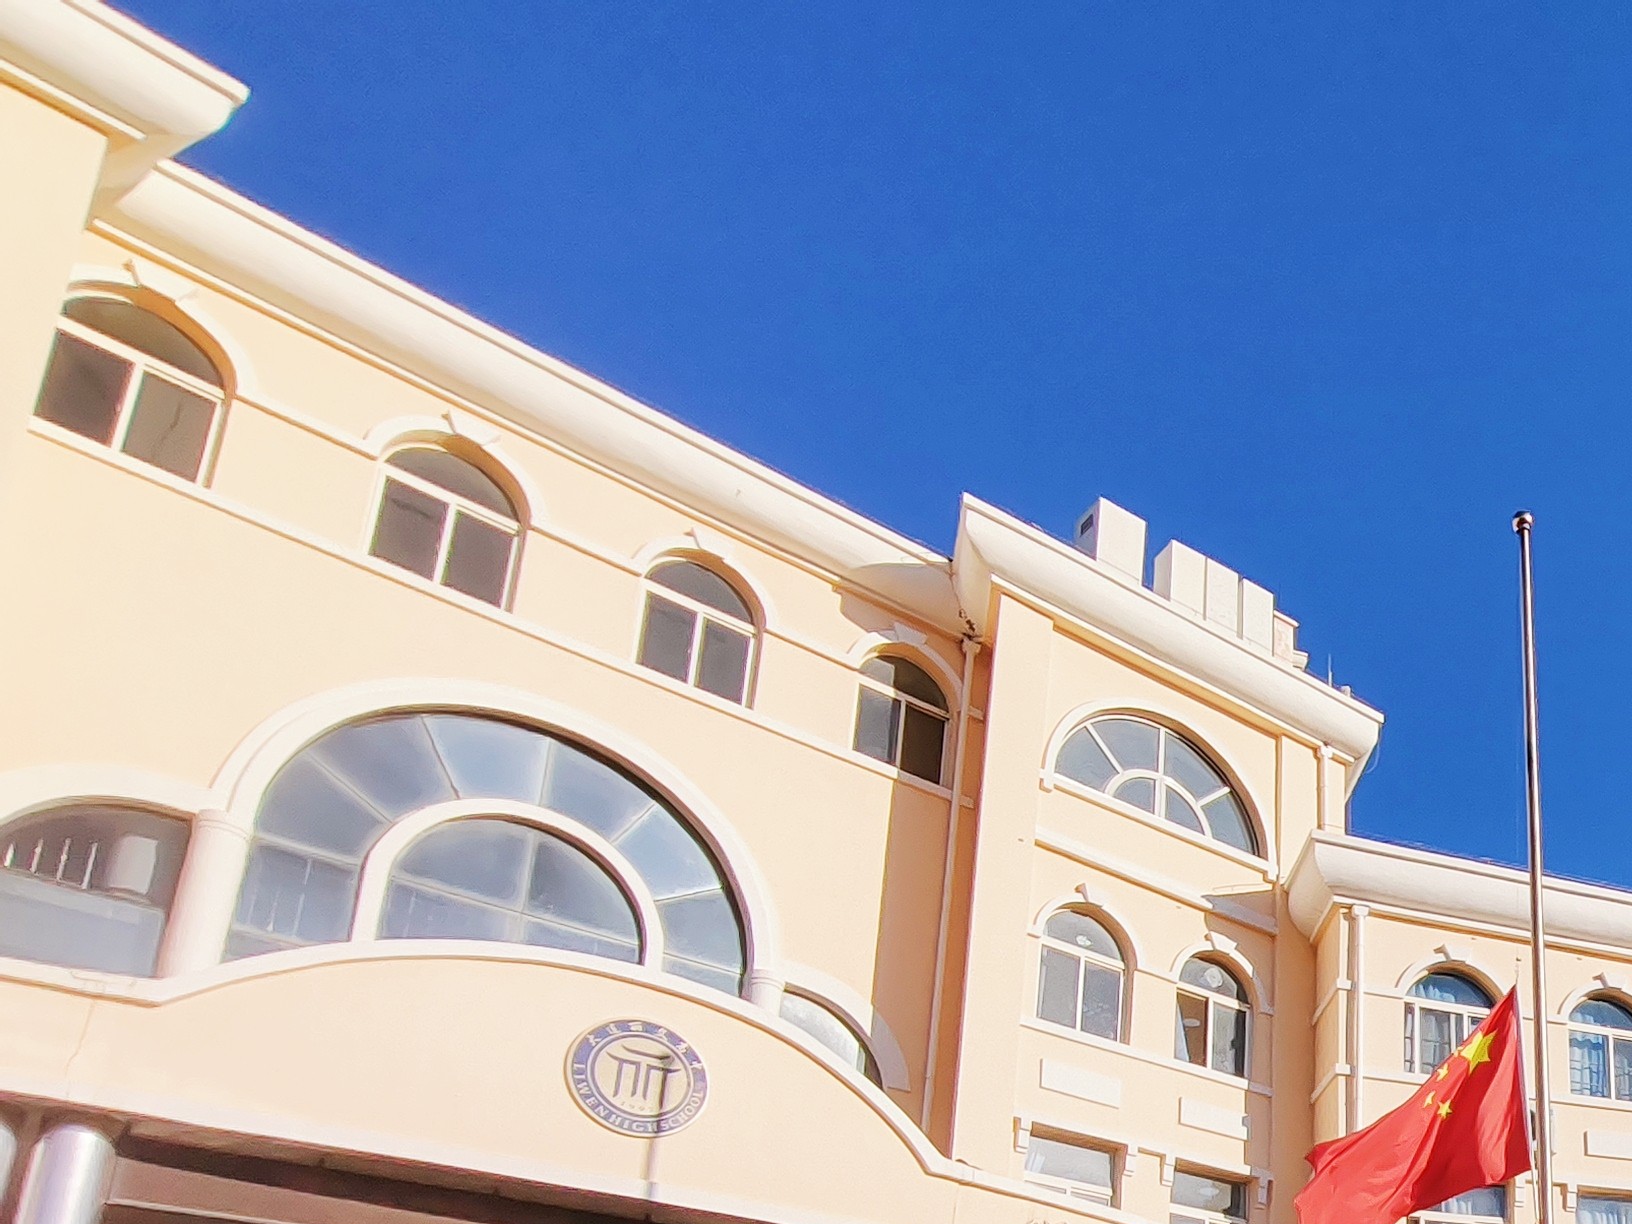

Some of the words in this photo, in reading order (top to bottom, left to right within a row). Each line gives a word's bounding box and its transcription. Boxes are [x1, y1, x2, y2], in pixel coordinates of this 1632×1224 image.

[573, 1062, 609, 1117] LIWEN
[608, 1113, 658, 1132] HIGH
[660, 1091, 704, 1131] SCHOOL
